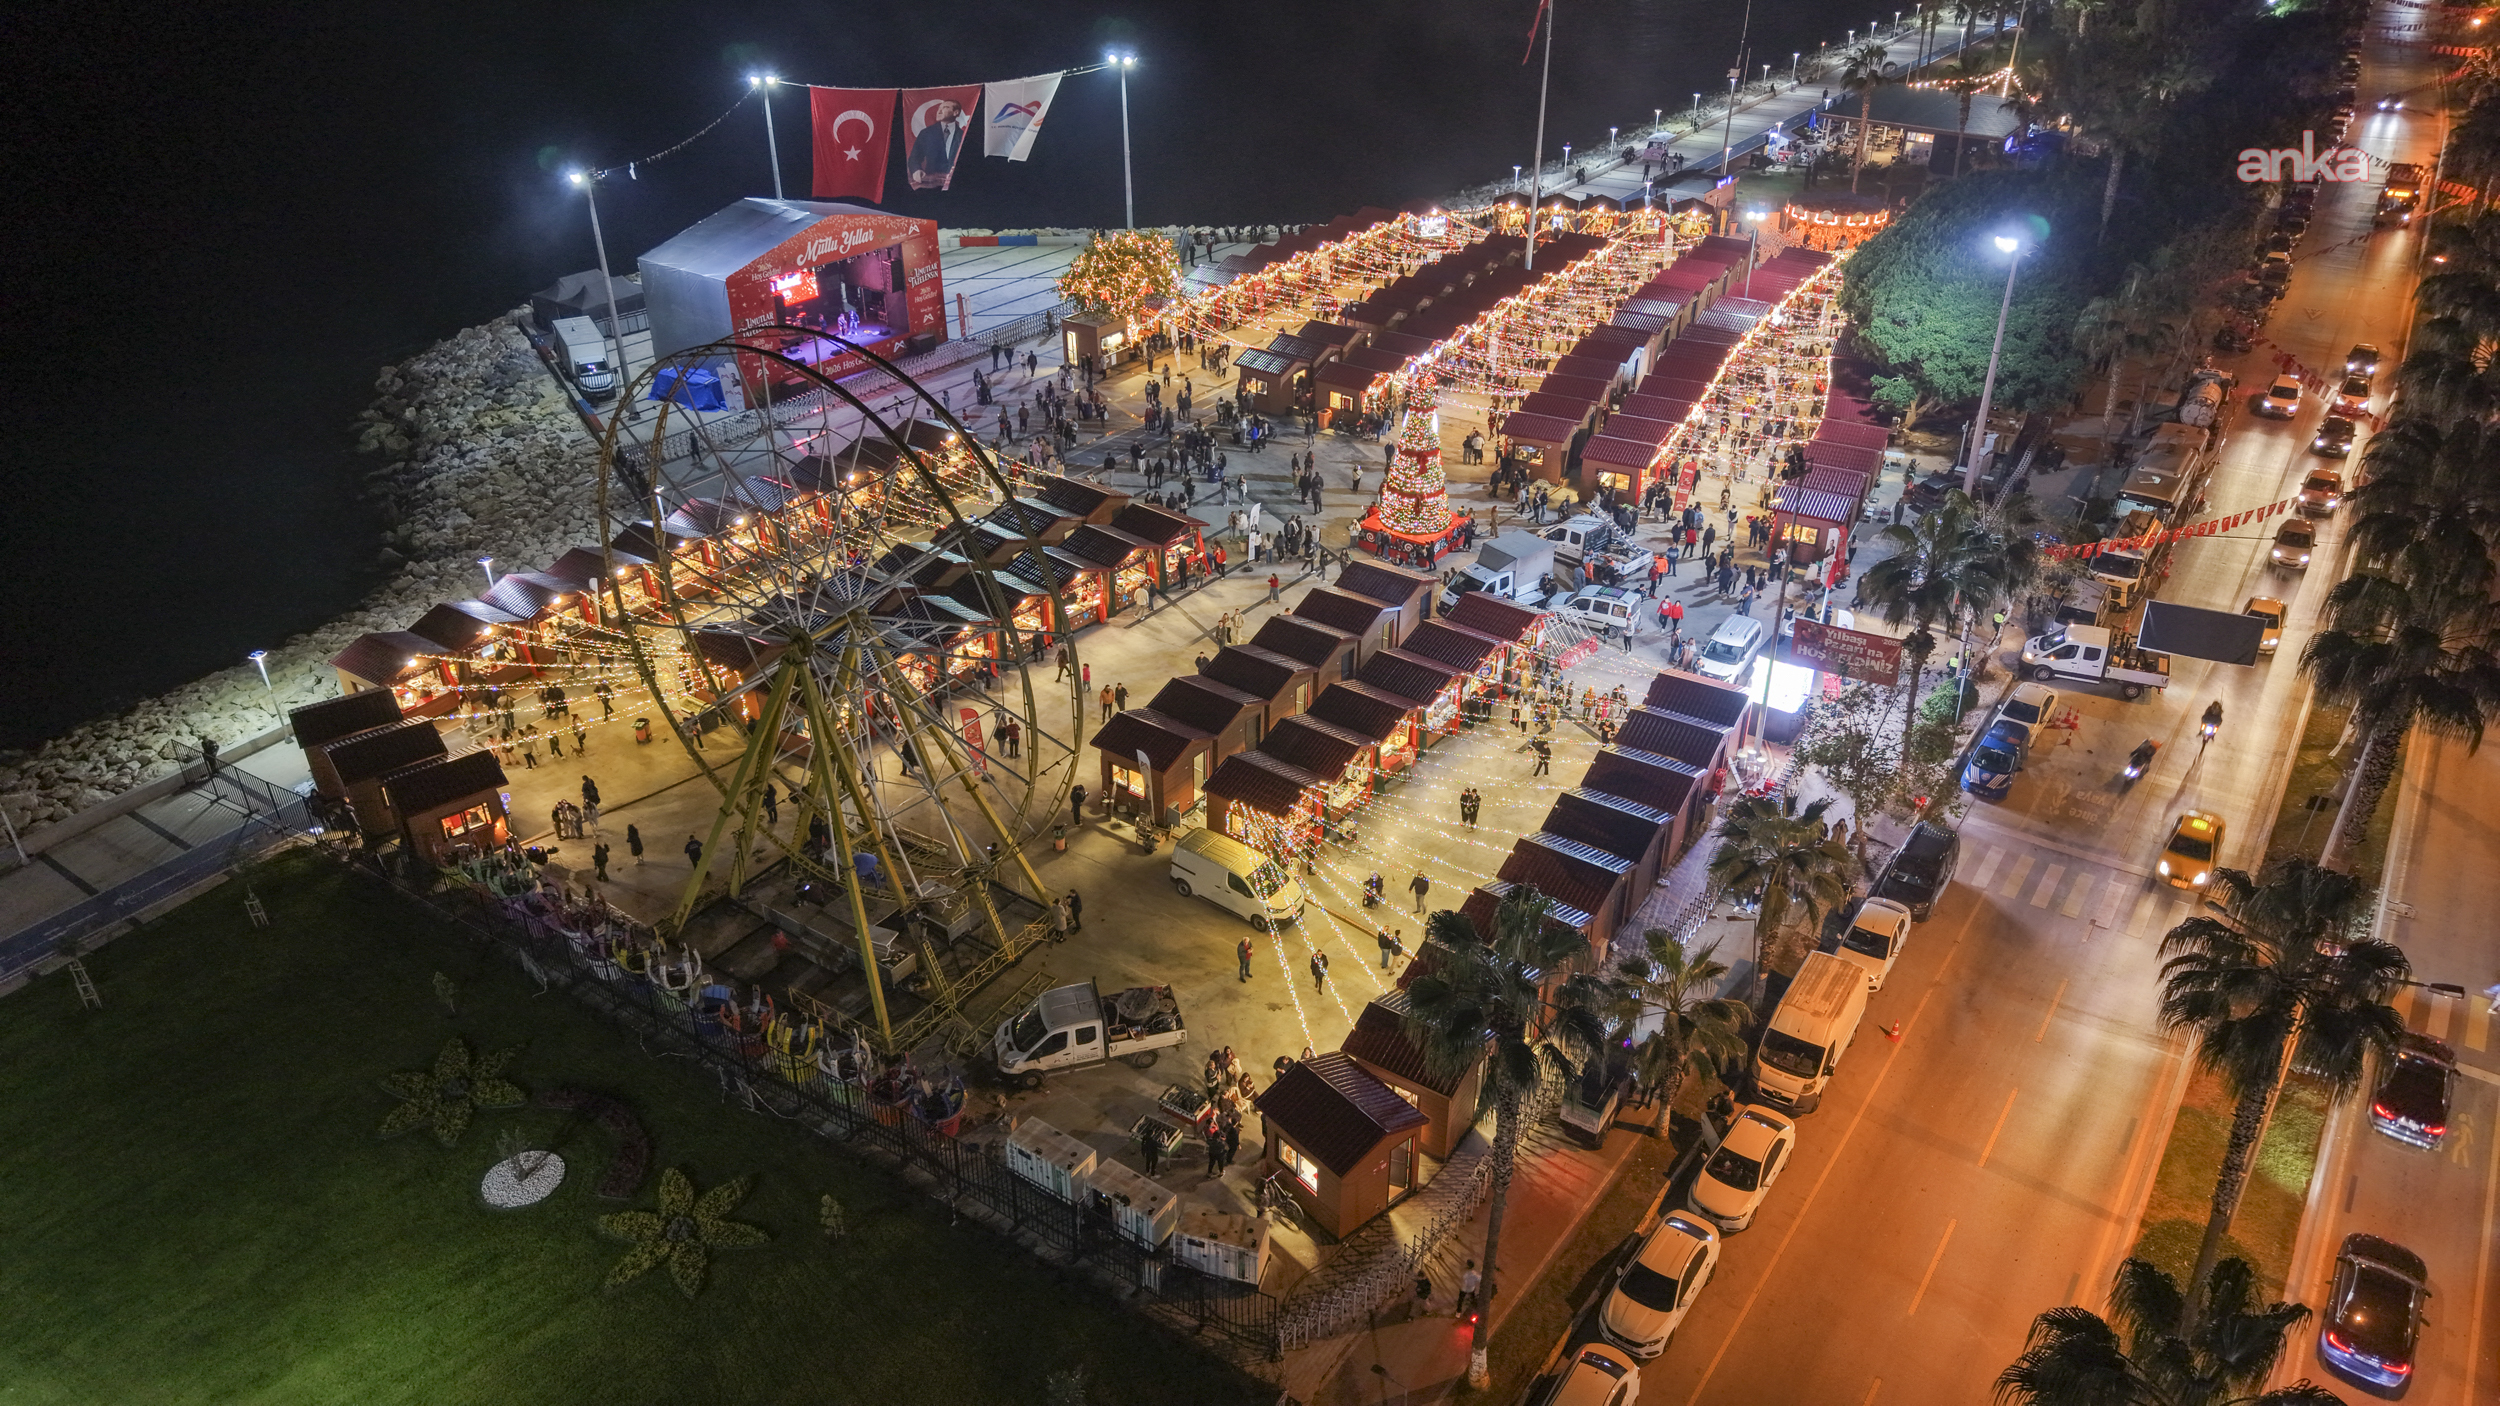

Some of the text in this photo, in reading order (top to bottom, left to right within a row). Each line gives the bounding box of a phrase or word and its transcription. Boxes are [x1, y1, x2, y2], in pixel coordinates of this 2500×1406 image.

[797, 228, 874, 267] Mutlu Yıllar
[1825, 629, 1867, 647] Yılbaşı
[1796, 644, 1827, 661] HOŞ
